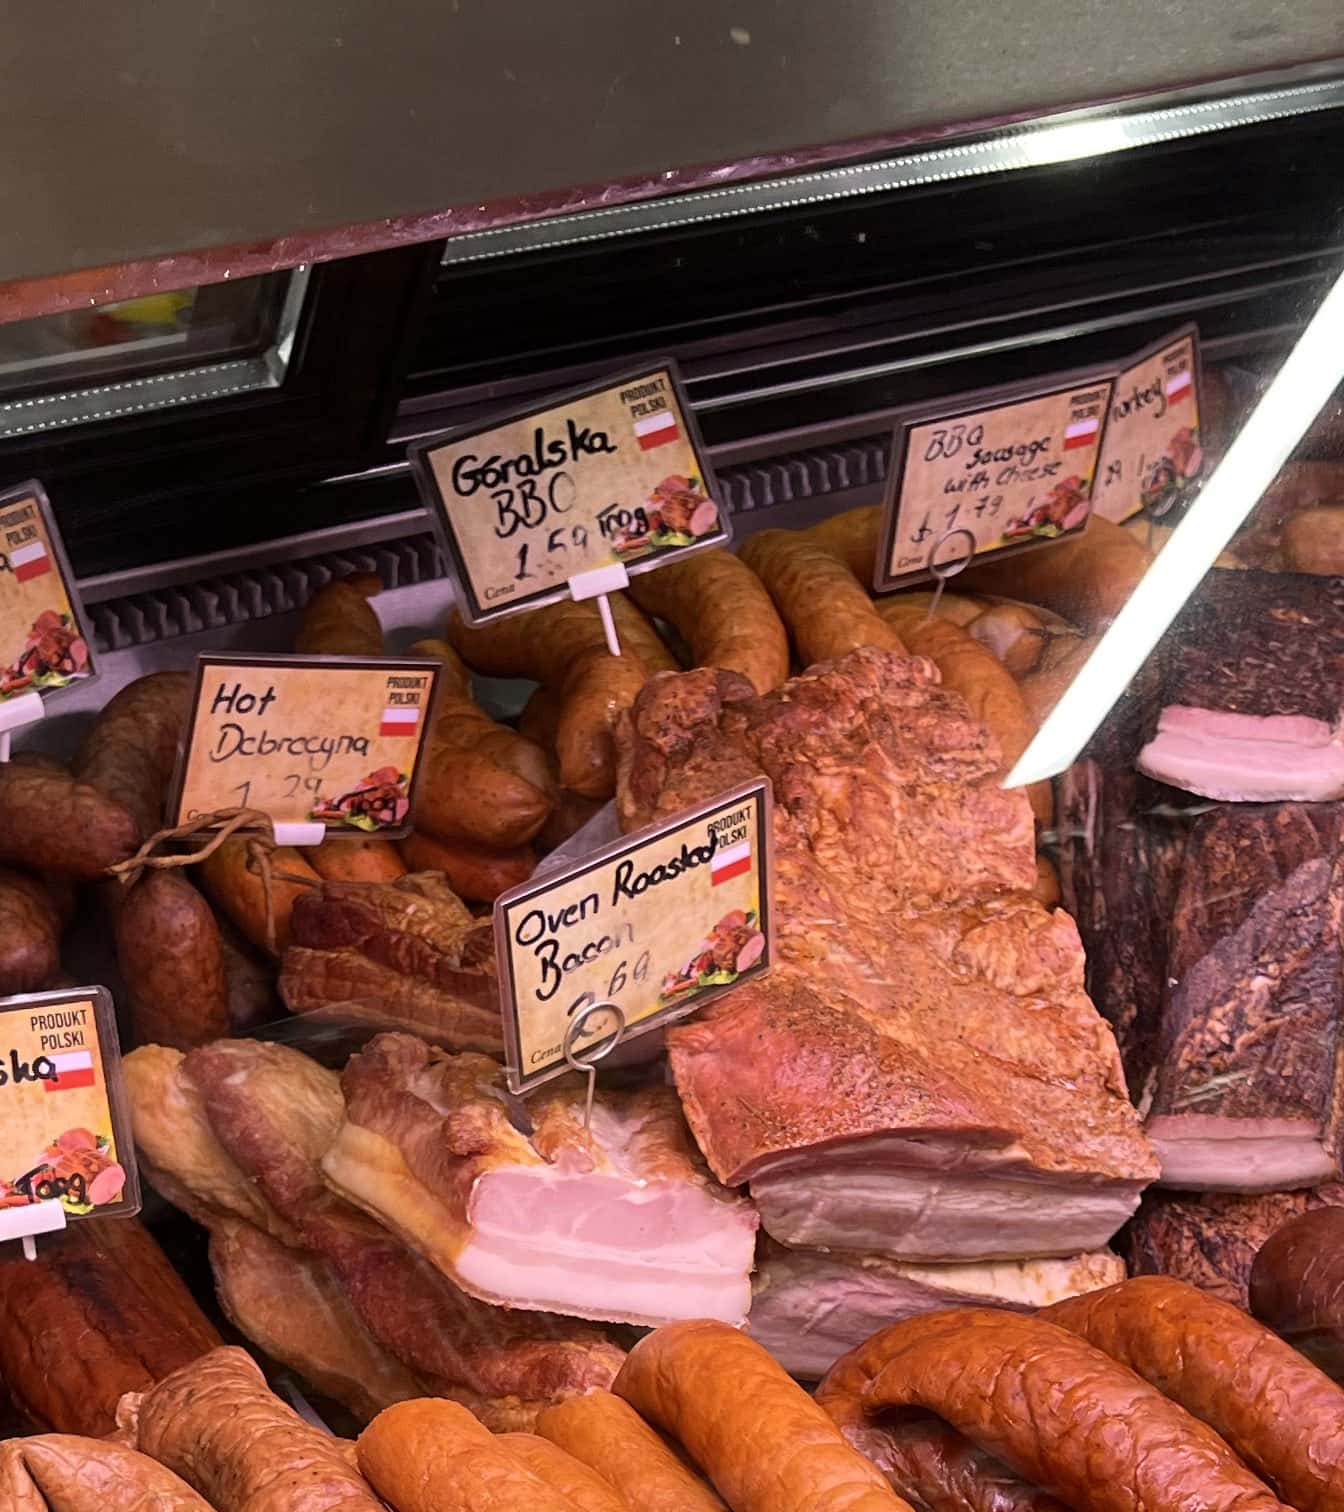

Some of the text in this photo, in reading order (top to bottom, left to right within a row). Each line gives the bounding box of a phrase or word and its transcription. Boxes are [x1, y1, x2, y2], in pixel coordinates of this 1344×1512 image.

[452, 418, 618, 498] Góralska
[210, 682, 276, 716] Hot
[516, 892, 599, 946] Oven
[534, 923, 635, 1001] Bacon
[30, 1009, 87, 1031] PRODUKT
[41, 1032, 84, 1050] POLSKI
